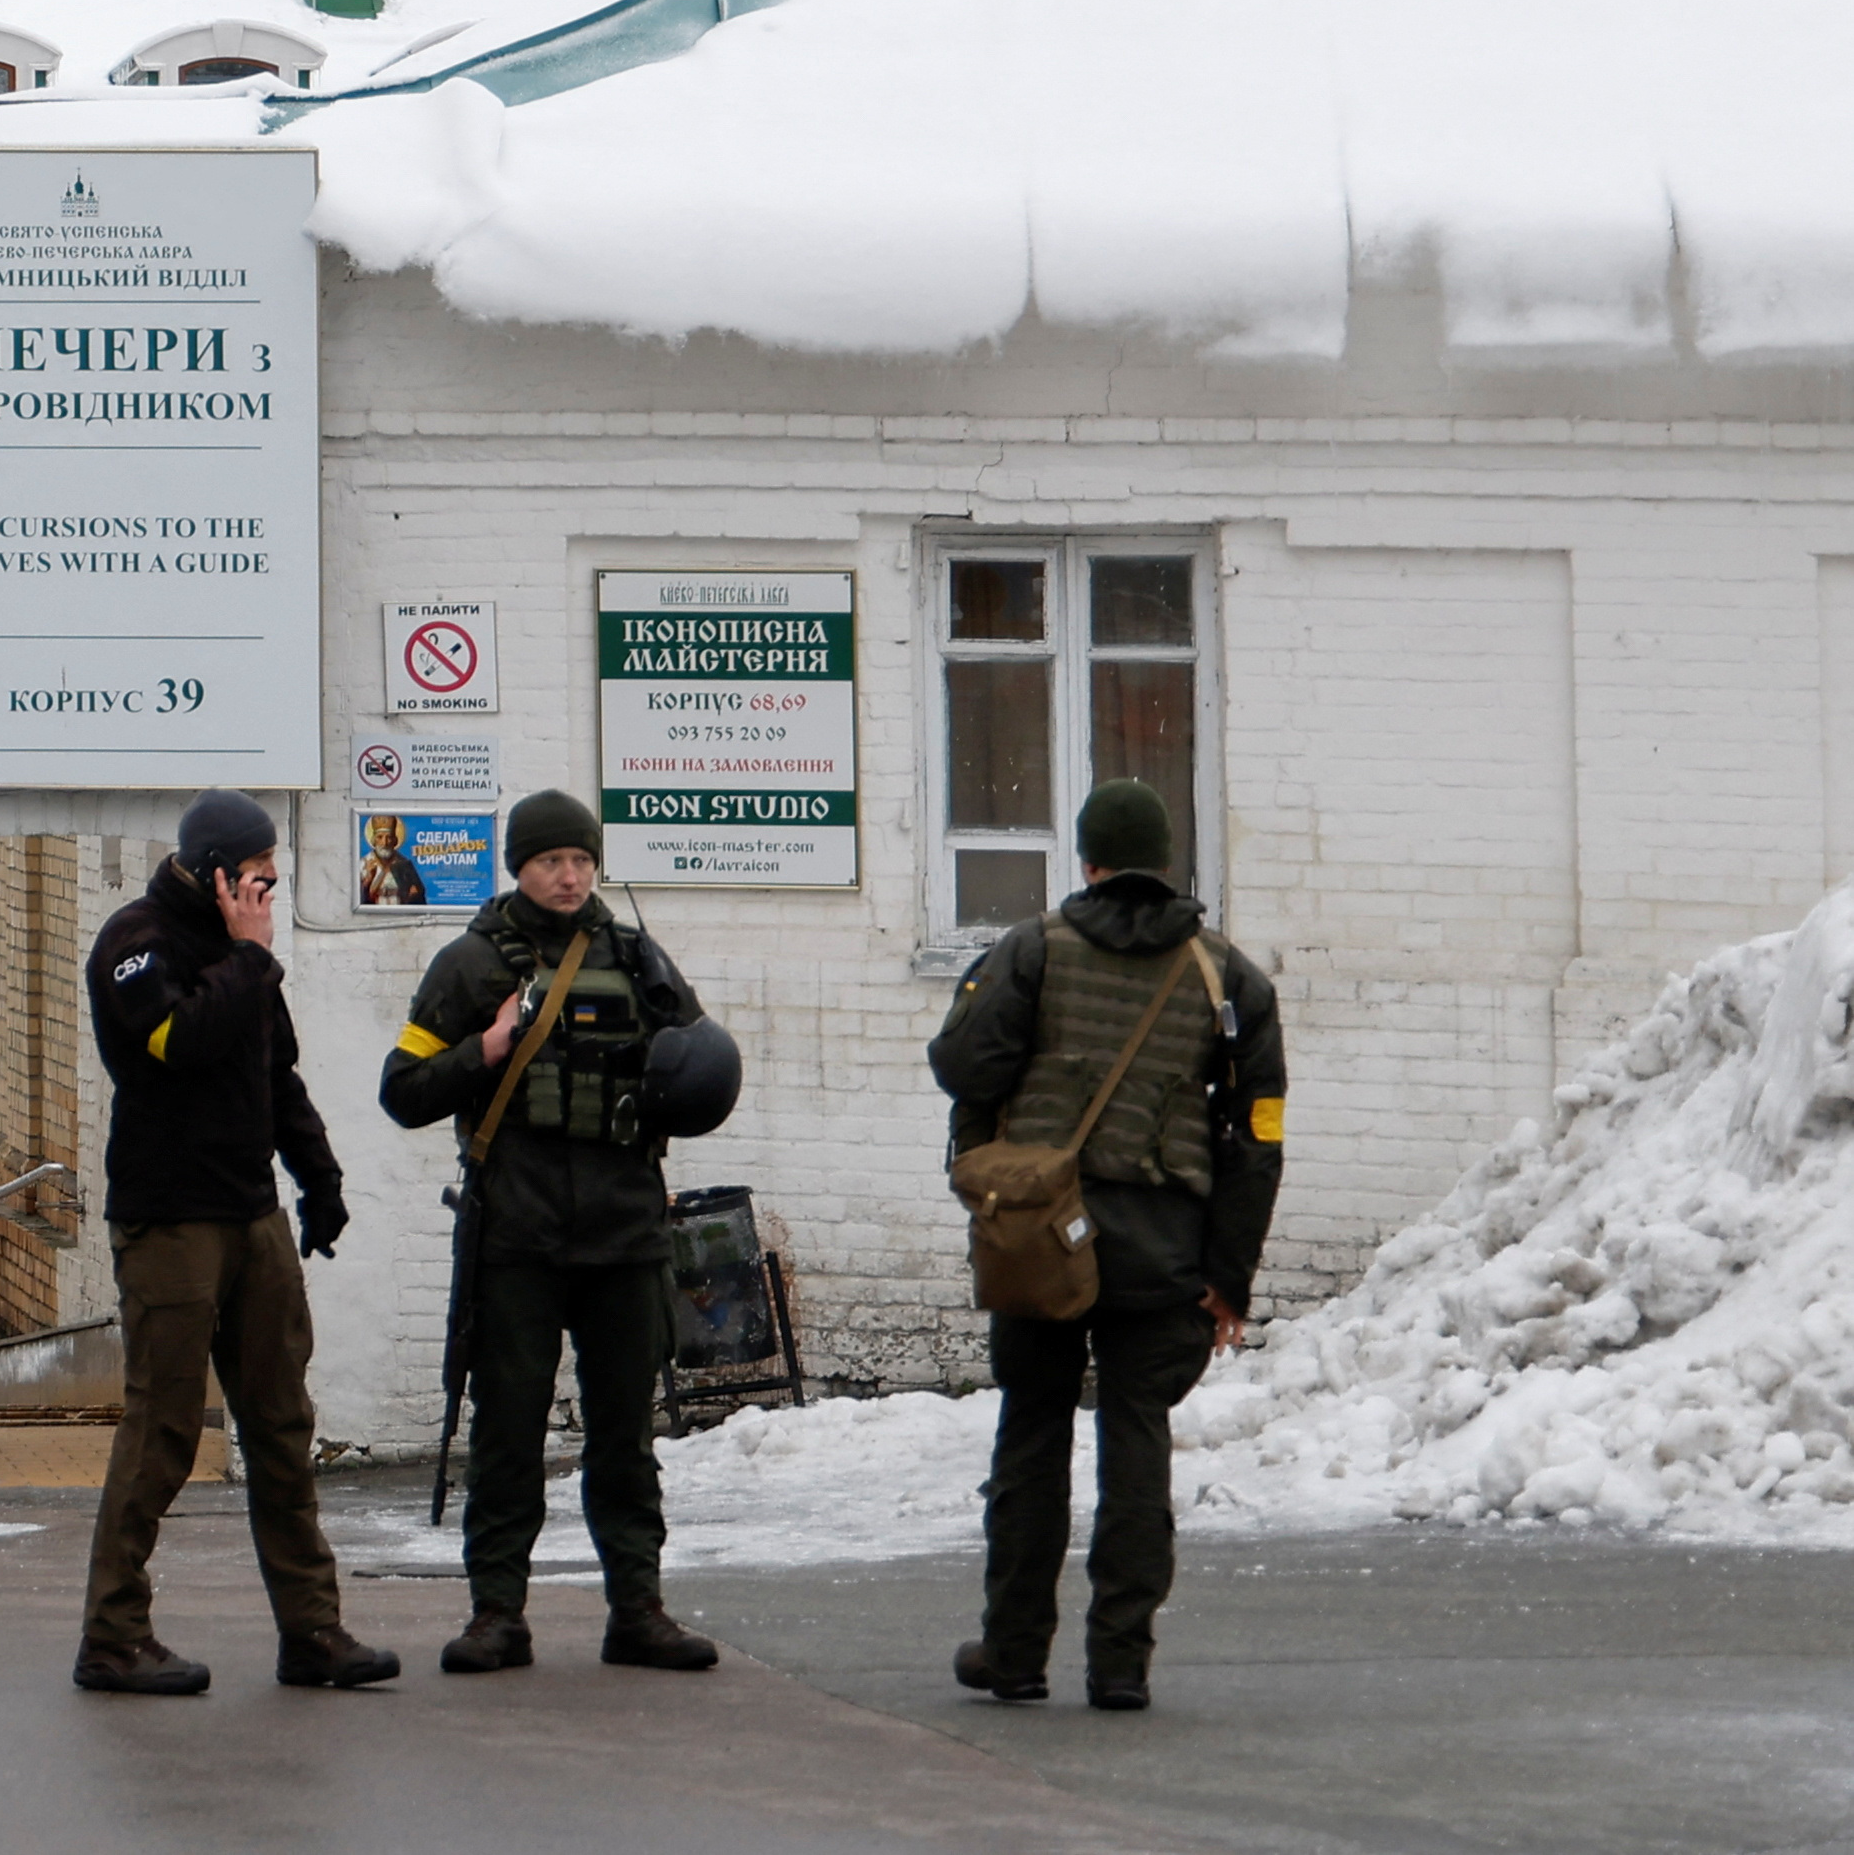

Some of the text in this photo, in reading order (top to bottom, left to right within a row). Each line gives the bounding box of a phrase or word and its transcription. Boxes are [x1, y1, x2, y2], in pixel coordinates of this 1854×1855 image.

[0, 226, 162, 241] СВЯТО-УСПЕНСЬКА
[138, 246, 193, 259] ЛАВРА
[159, 270, 245, 289] ВІДДІЛ
[156, 518, 195, 537] TO
[205, 518, 263, 538] THE
[61, 553, 139, 572] WITH
[149, 554, 166, 572] A
[176, 554, 268, 573] GUIDE
[399, 605, 479, 616] НЕ ПАЛИТИ
[623, 620, 828, 645] ІКОНОПИСНА
[624, 644, 828, 672] МАЙСТЕРНЯ
[10, 678, 204, 713] КОРПУС 39
[398, 698, 487, 709] NO SMOKING
[649, 693, 805, 715] КОРПУС 68,69
[668, 726, 786, 741] 093 755 20 09
[412, 745, 489, 753] ВИДЕОСЪЕМКА
[623, 758, 833, 772] ІКОНИ НА ЗАМОВЛЕННЯ
[412, 779, 491, 790] ЗАПРЕЩЕНА!
[628, 795, 829, 820] ICON STUDIO
[417, 830, 469, 844] СДЕЛАЙ
[412, 839, 487, 856] ПОДАРОК
[647, 839, 814, 853] www.icon-master.com
[417, 853, 477, 865] СИРОТАМ
[113, 951, 151, 983] СБУ
